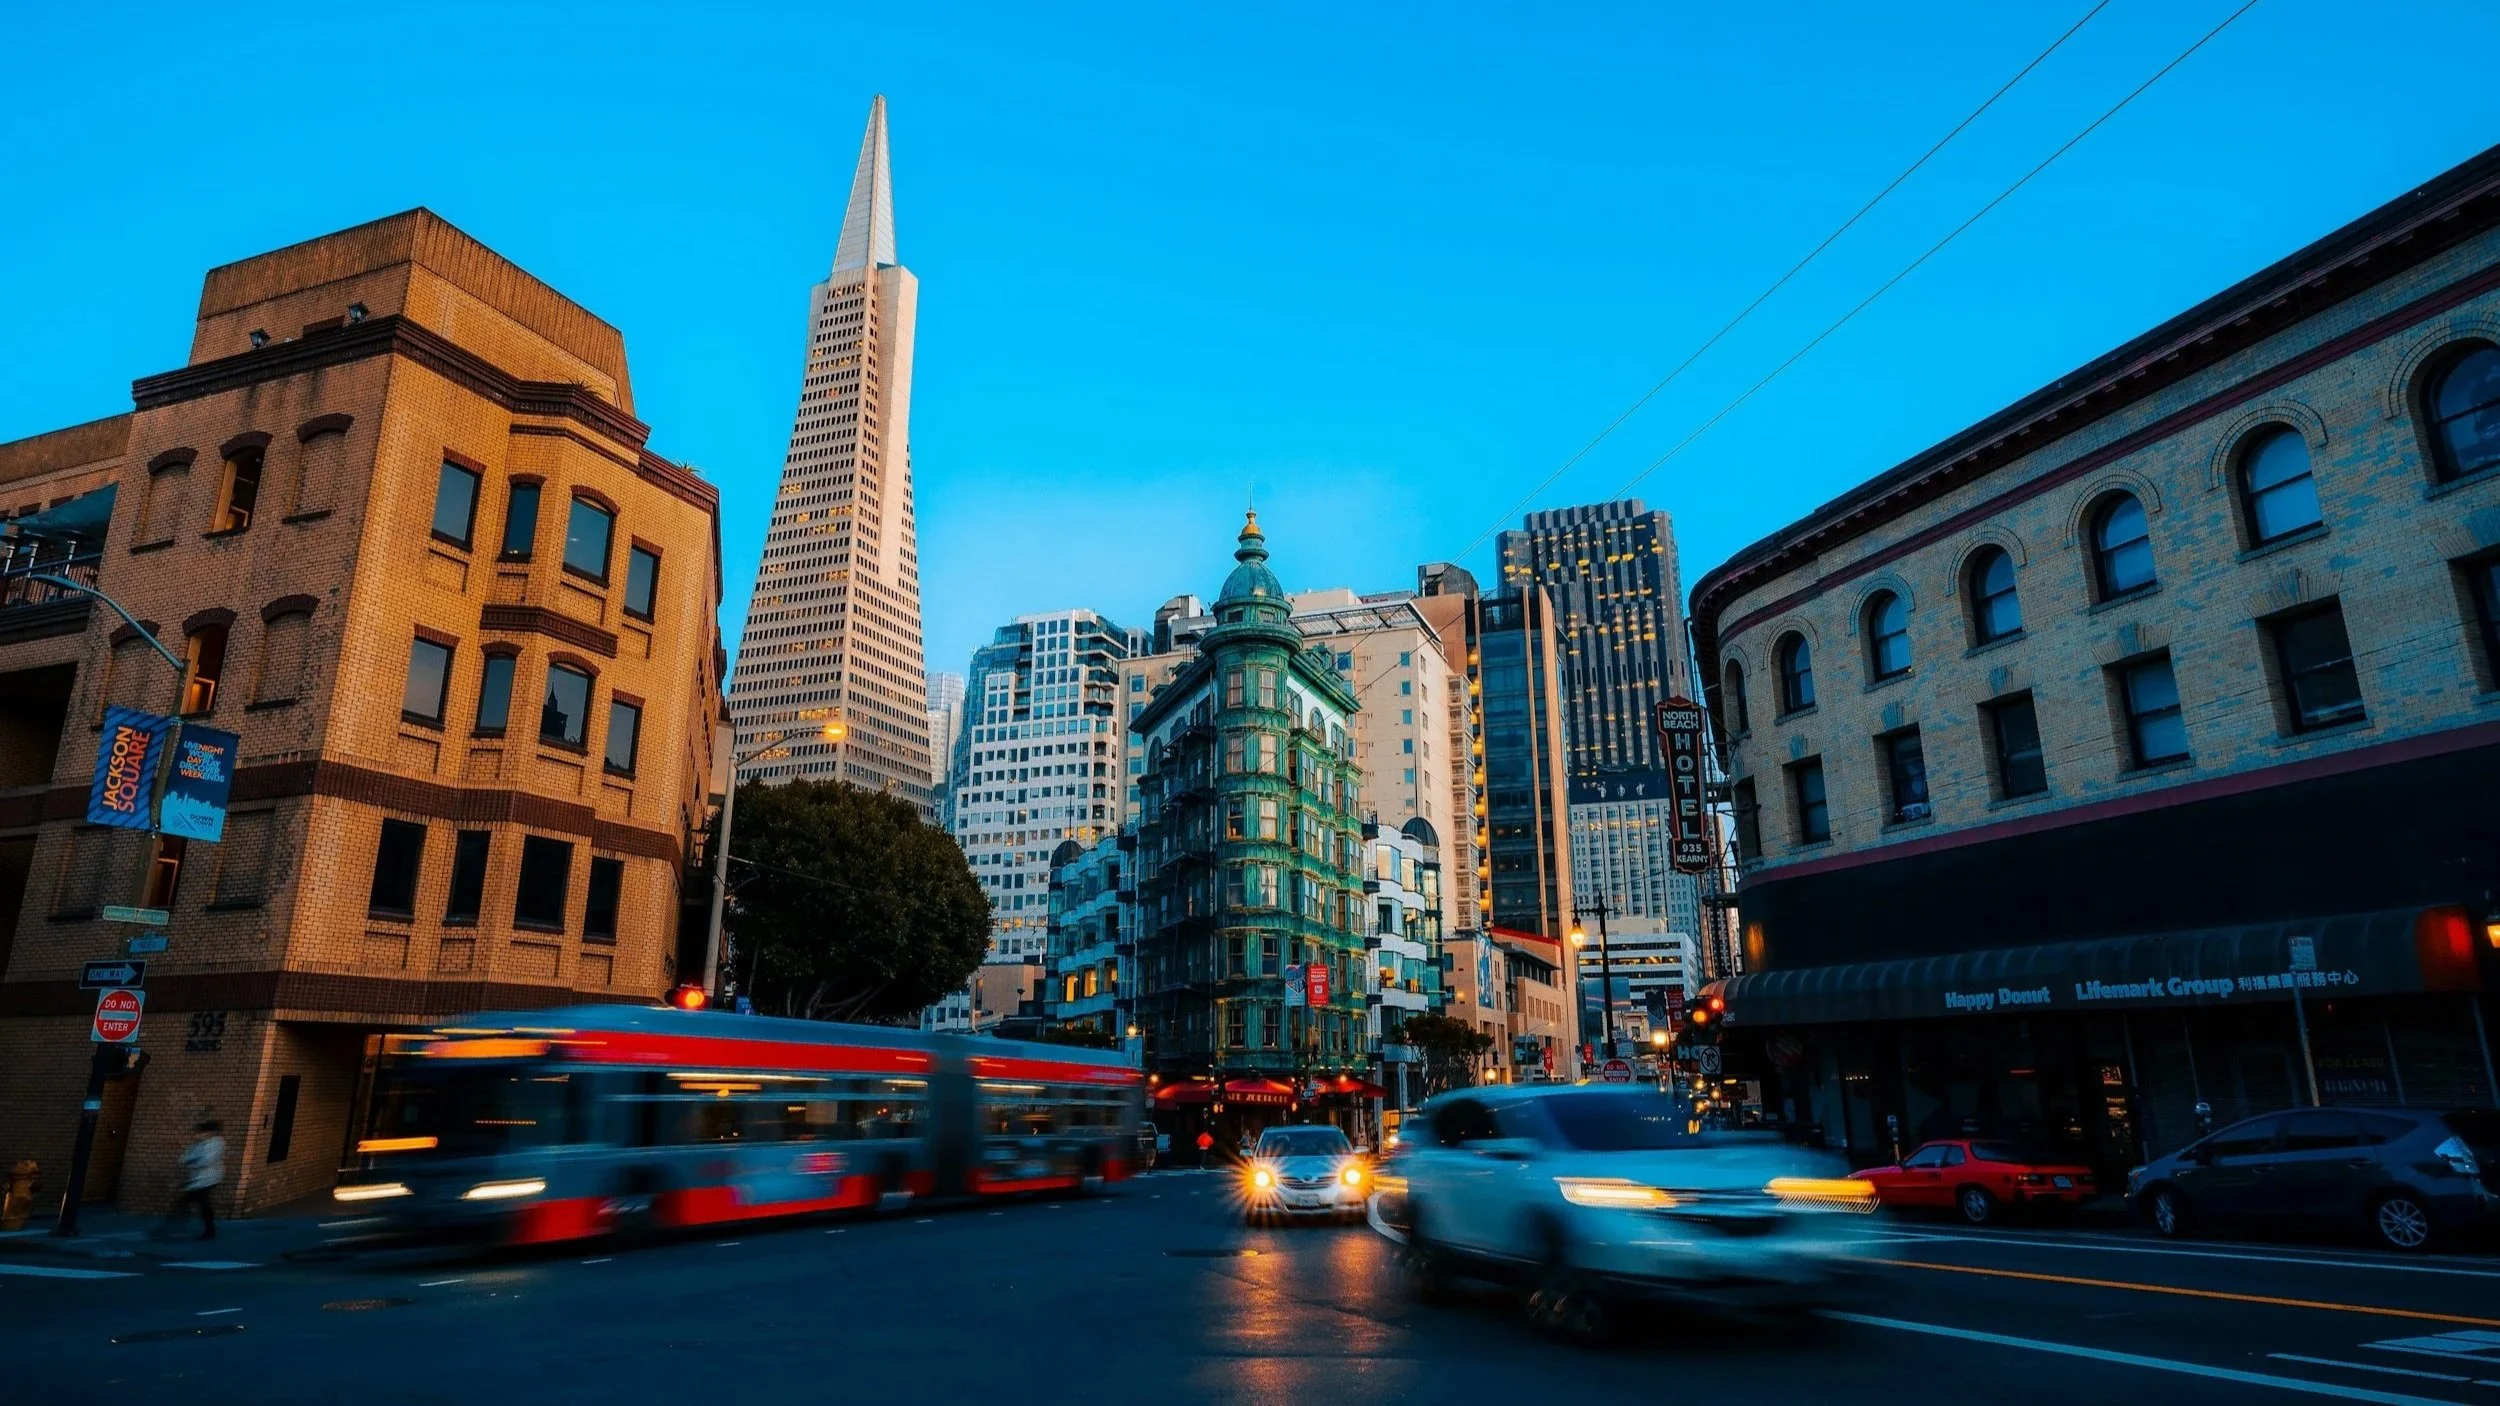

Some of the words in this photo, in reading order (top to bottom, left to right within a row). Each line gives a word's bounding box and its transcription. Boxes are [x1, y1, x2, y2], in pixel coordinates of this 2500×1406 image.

[1663, 711, 1699, 720] NORTH
[1663, 720, 1699, 729] BEACH
[189, 750, 215, 760] WORK
[103, 726, 133, 810] JACKSON
[117, 730, 150, 813] SQUARE
[179, 762, 220, 774] DISCOVER
[180, 769, 225, 782] WEEKENDS
[1675, 733, 1700, 839] HOTEL
[190, 813, 214, 823] DOWN
[1682, 843, 1702, 853] 935
[1677, 855, 1708, 864] KEARNY
[90, 969, 107, 979] ONE
[109, 968, 125, 979] WAY
[2075, 978, 2165, 1000] Lifemark
[2167, 977, 2233, 998] Group
[105, 1000, 117, 1009] DO
[120, 1000, 137, 1009] NOT
[1945, 992, 1994, 1011] Happy
[1998, 988, 2051, 1004] Donut
[103, 1023, 129, 1031] ENTER
